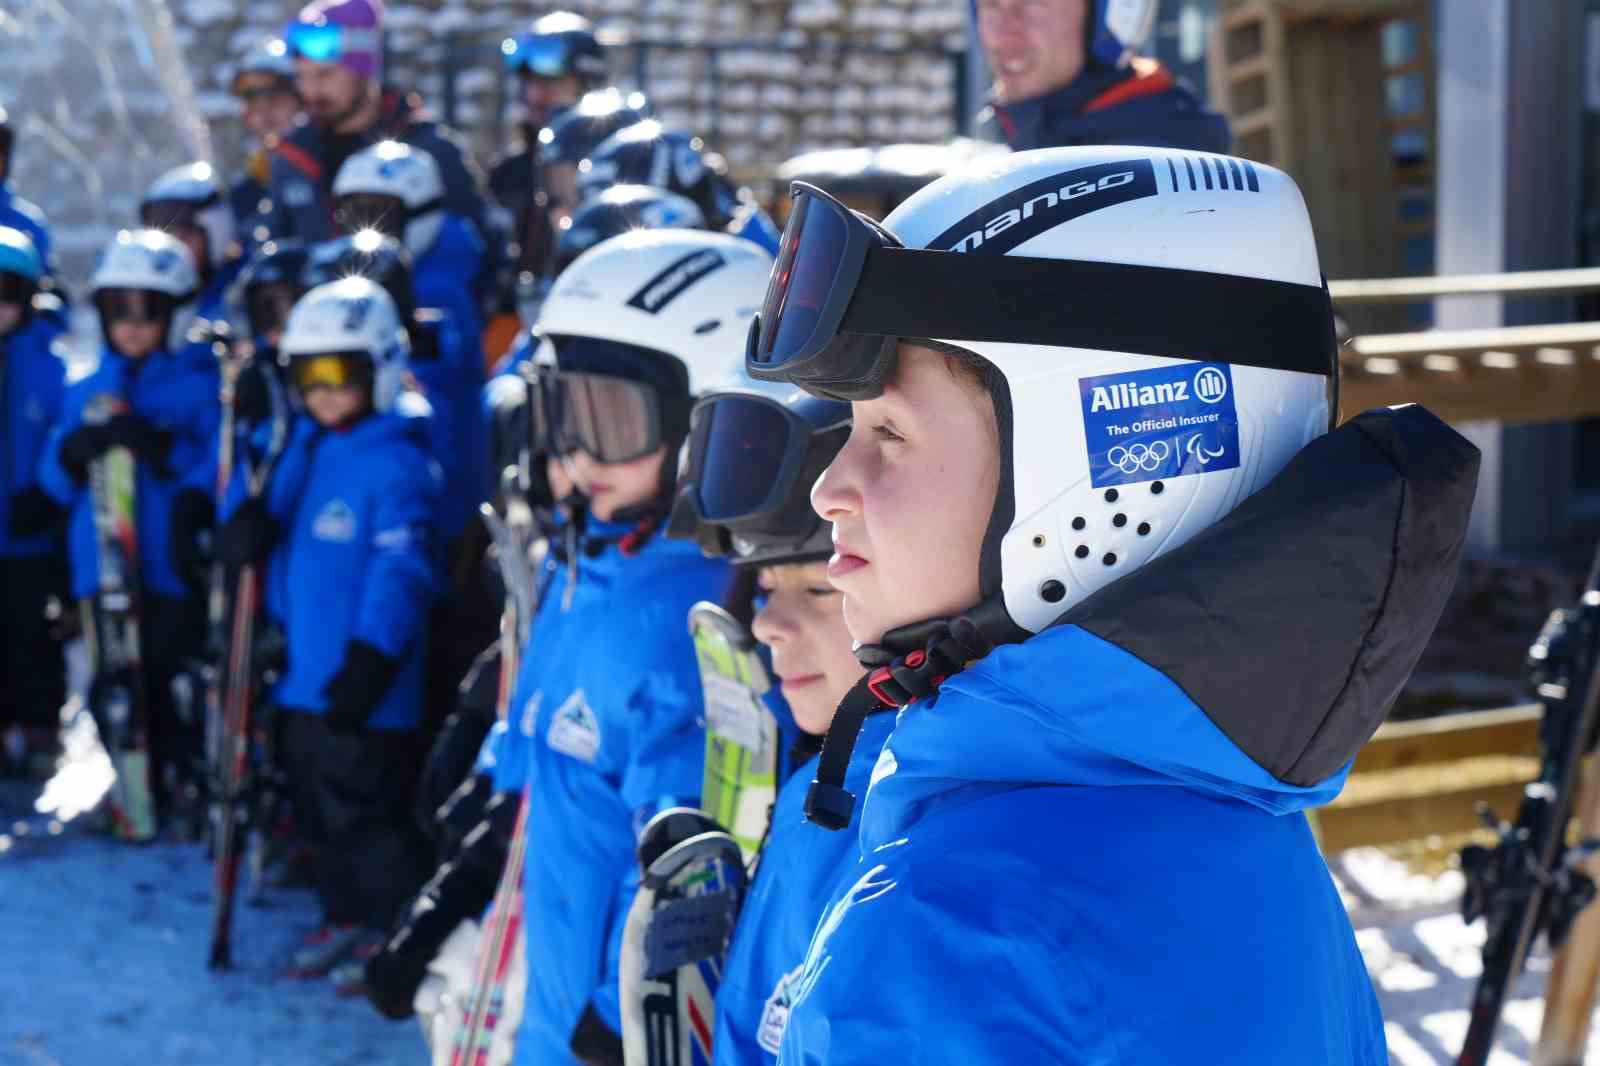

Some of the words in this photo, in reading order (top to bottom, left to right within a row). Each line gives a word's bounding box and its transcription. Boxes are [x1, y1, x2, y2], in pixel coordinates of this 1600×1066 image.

[1091, 381, 1190, 413] Allianz
[1105, 425, 1130, 437] The
[1132, 419, 1177, 433] Official
[1179, 413, 1220, 426] Insurer
